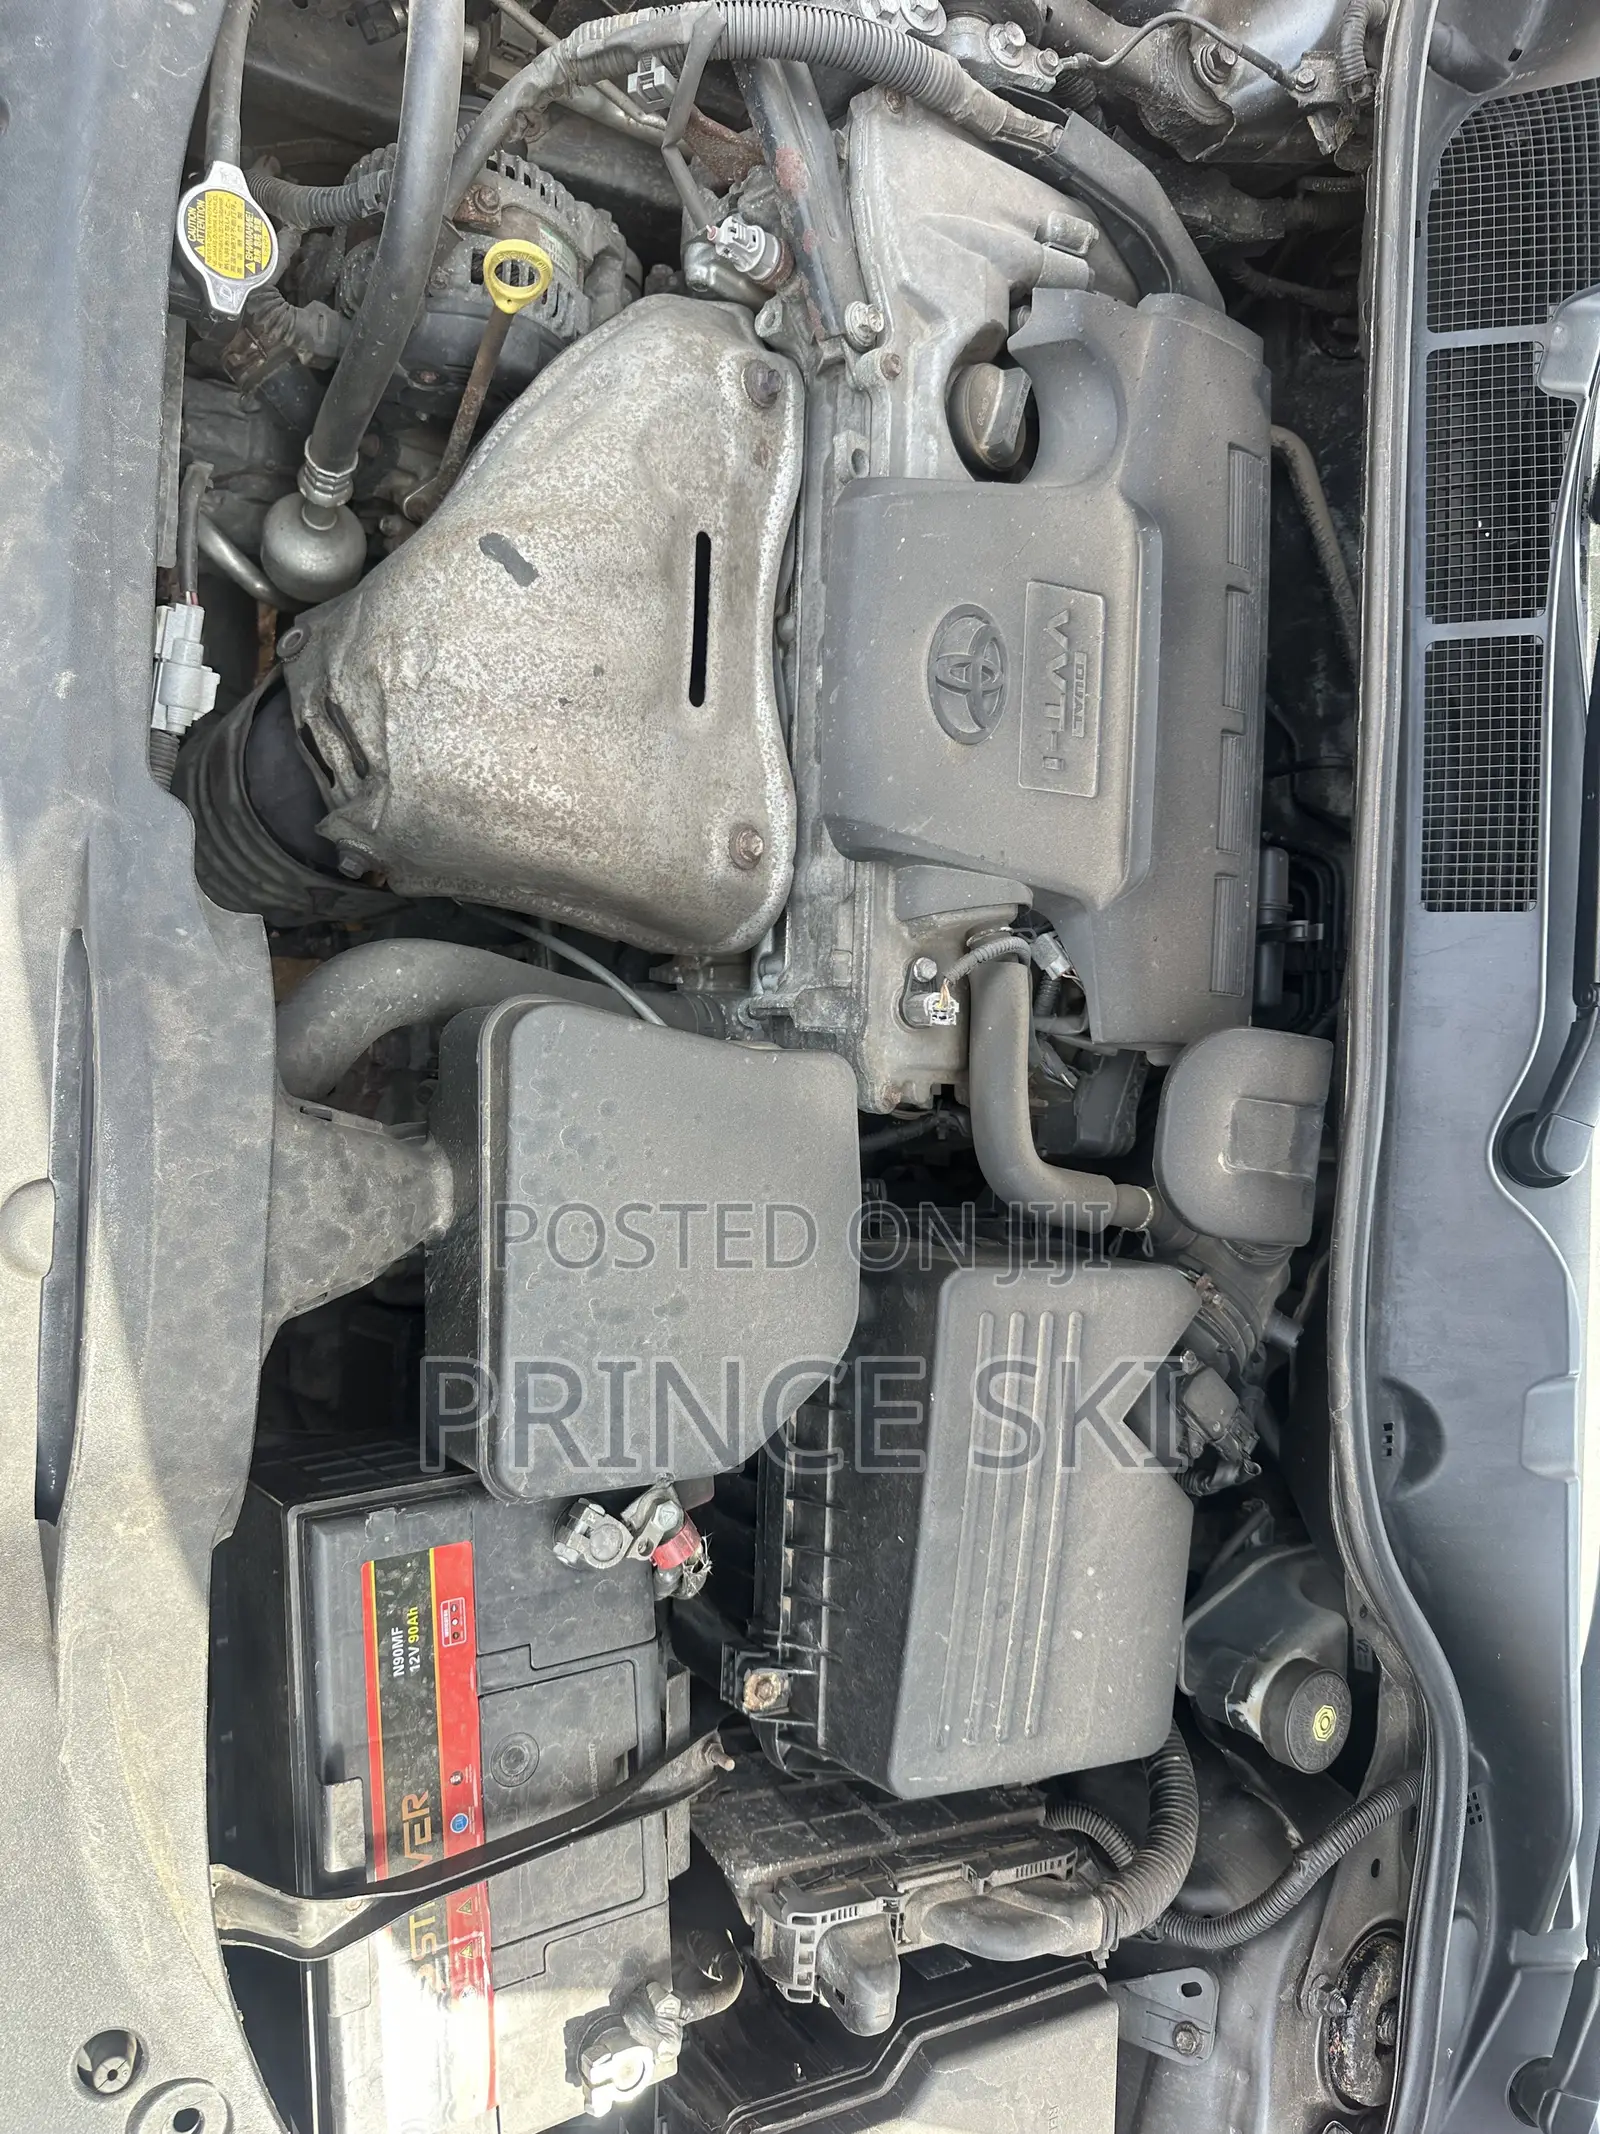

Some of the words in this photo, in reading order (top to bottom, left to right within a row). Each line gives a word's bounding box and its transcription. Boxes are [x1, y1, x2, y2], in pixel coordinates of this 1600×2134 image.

[187, 206, 196, 242] CAUTION
[195, 198, 206, 246] ATTENTION
[245, 211, 254, 262] ВНИМАНИЕ!
[495, 251, 533, 262] ENGINE
[1072, 663, 1086, 730] DUAL
[406, 1605, 421, 1645] 90Ah
[392, 1626, 406, 1677] N90MF
[408, 1647, 422, 1673] 12V
